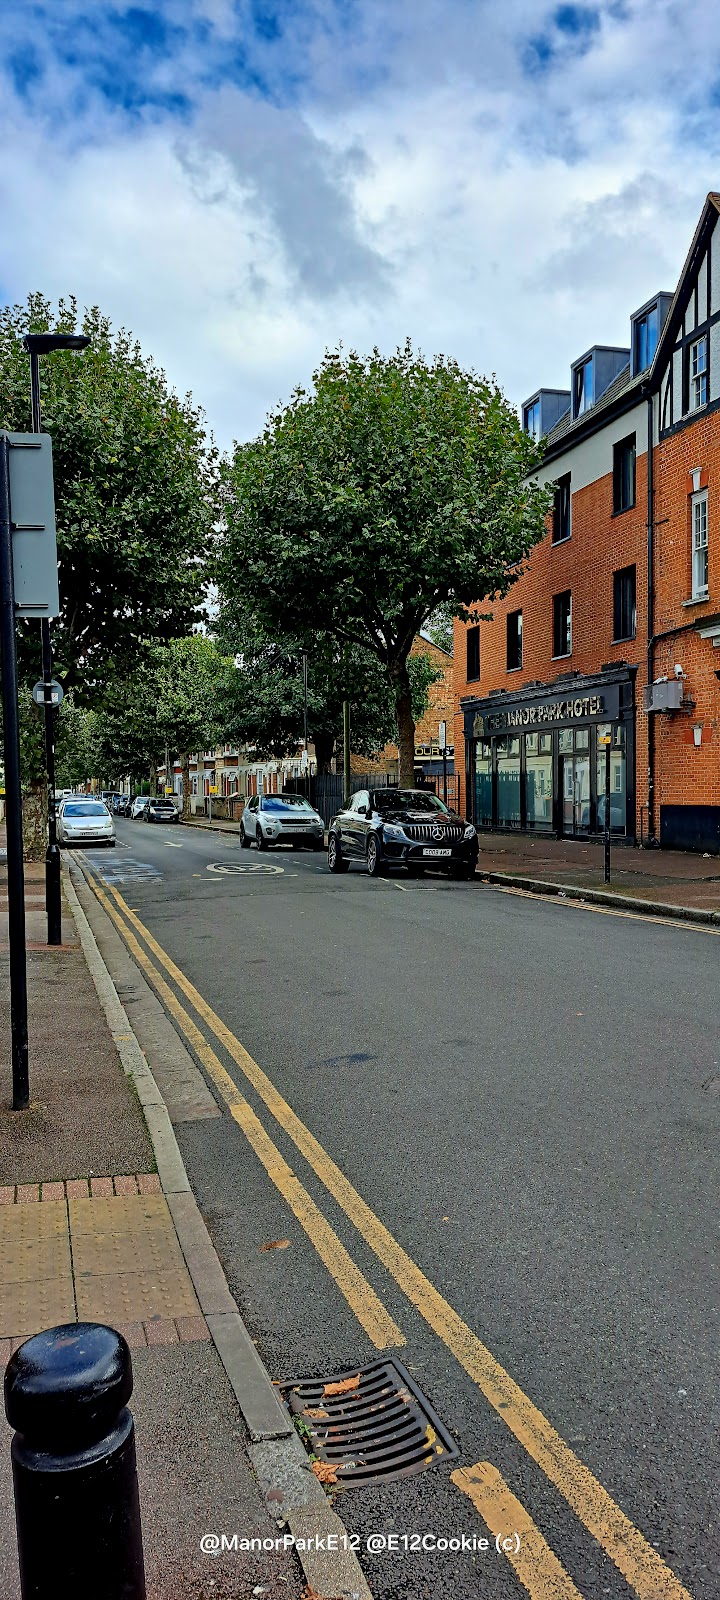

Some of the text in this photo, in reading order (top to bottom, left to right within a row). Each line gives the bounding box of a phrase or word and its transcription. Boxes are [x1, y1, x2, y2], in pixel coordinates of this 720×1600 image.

[502, 707, 536, 727] MANOR
[537, 702, 564, 722] PARK
[566, 696, 603, 718] HOTEL
